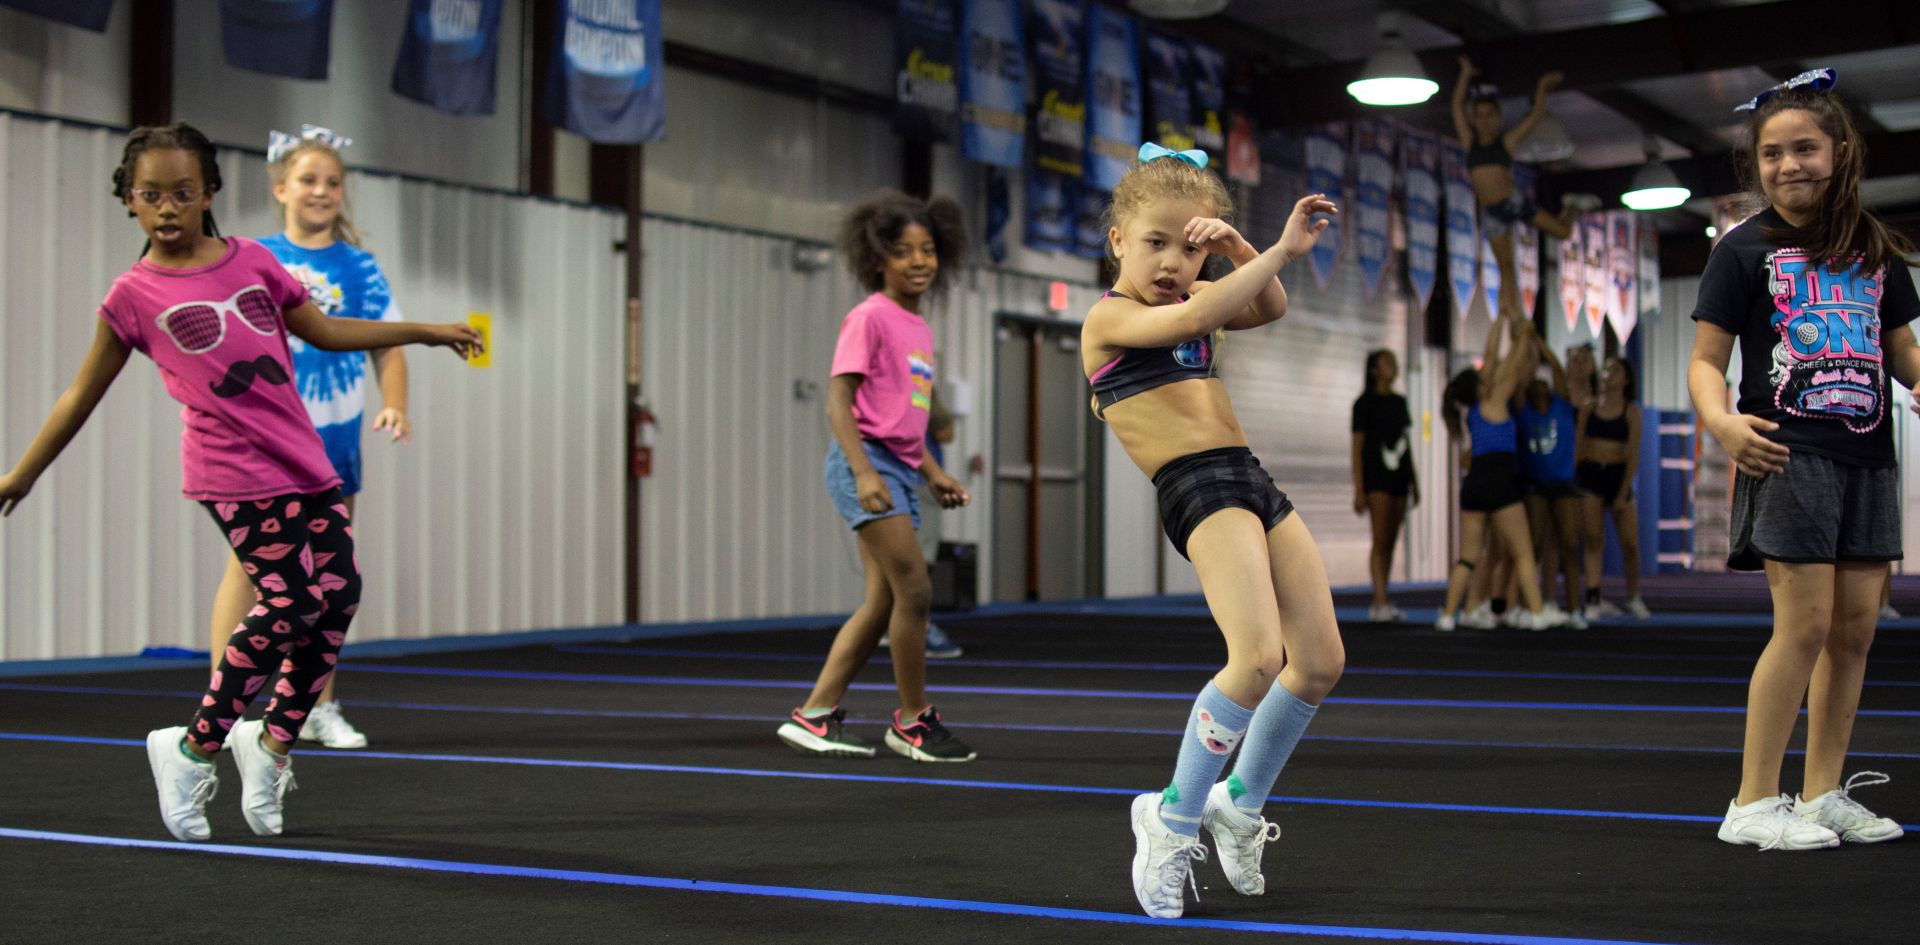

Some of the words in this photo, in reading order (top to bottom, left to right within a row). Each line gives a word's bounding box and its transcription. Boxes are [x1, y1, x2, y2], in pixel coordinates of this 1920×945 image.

[1776, 257, 1879, 306] THE
[1786, 311, 1880, 359] ONE
[1798, 360, 1826, 370] CHEER
[1835, 360, 1860, 368] DANCE
